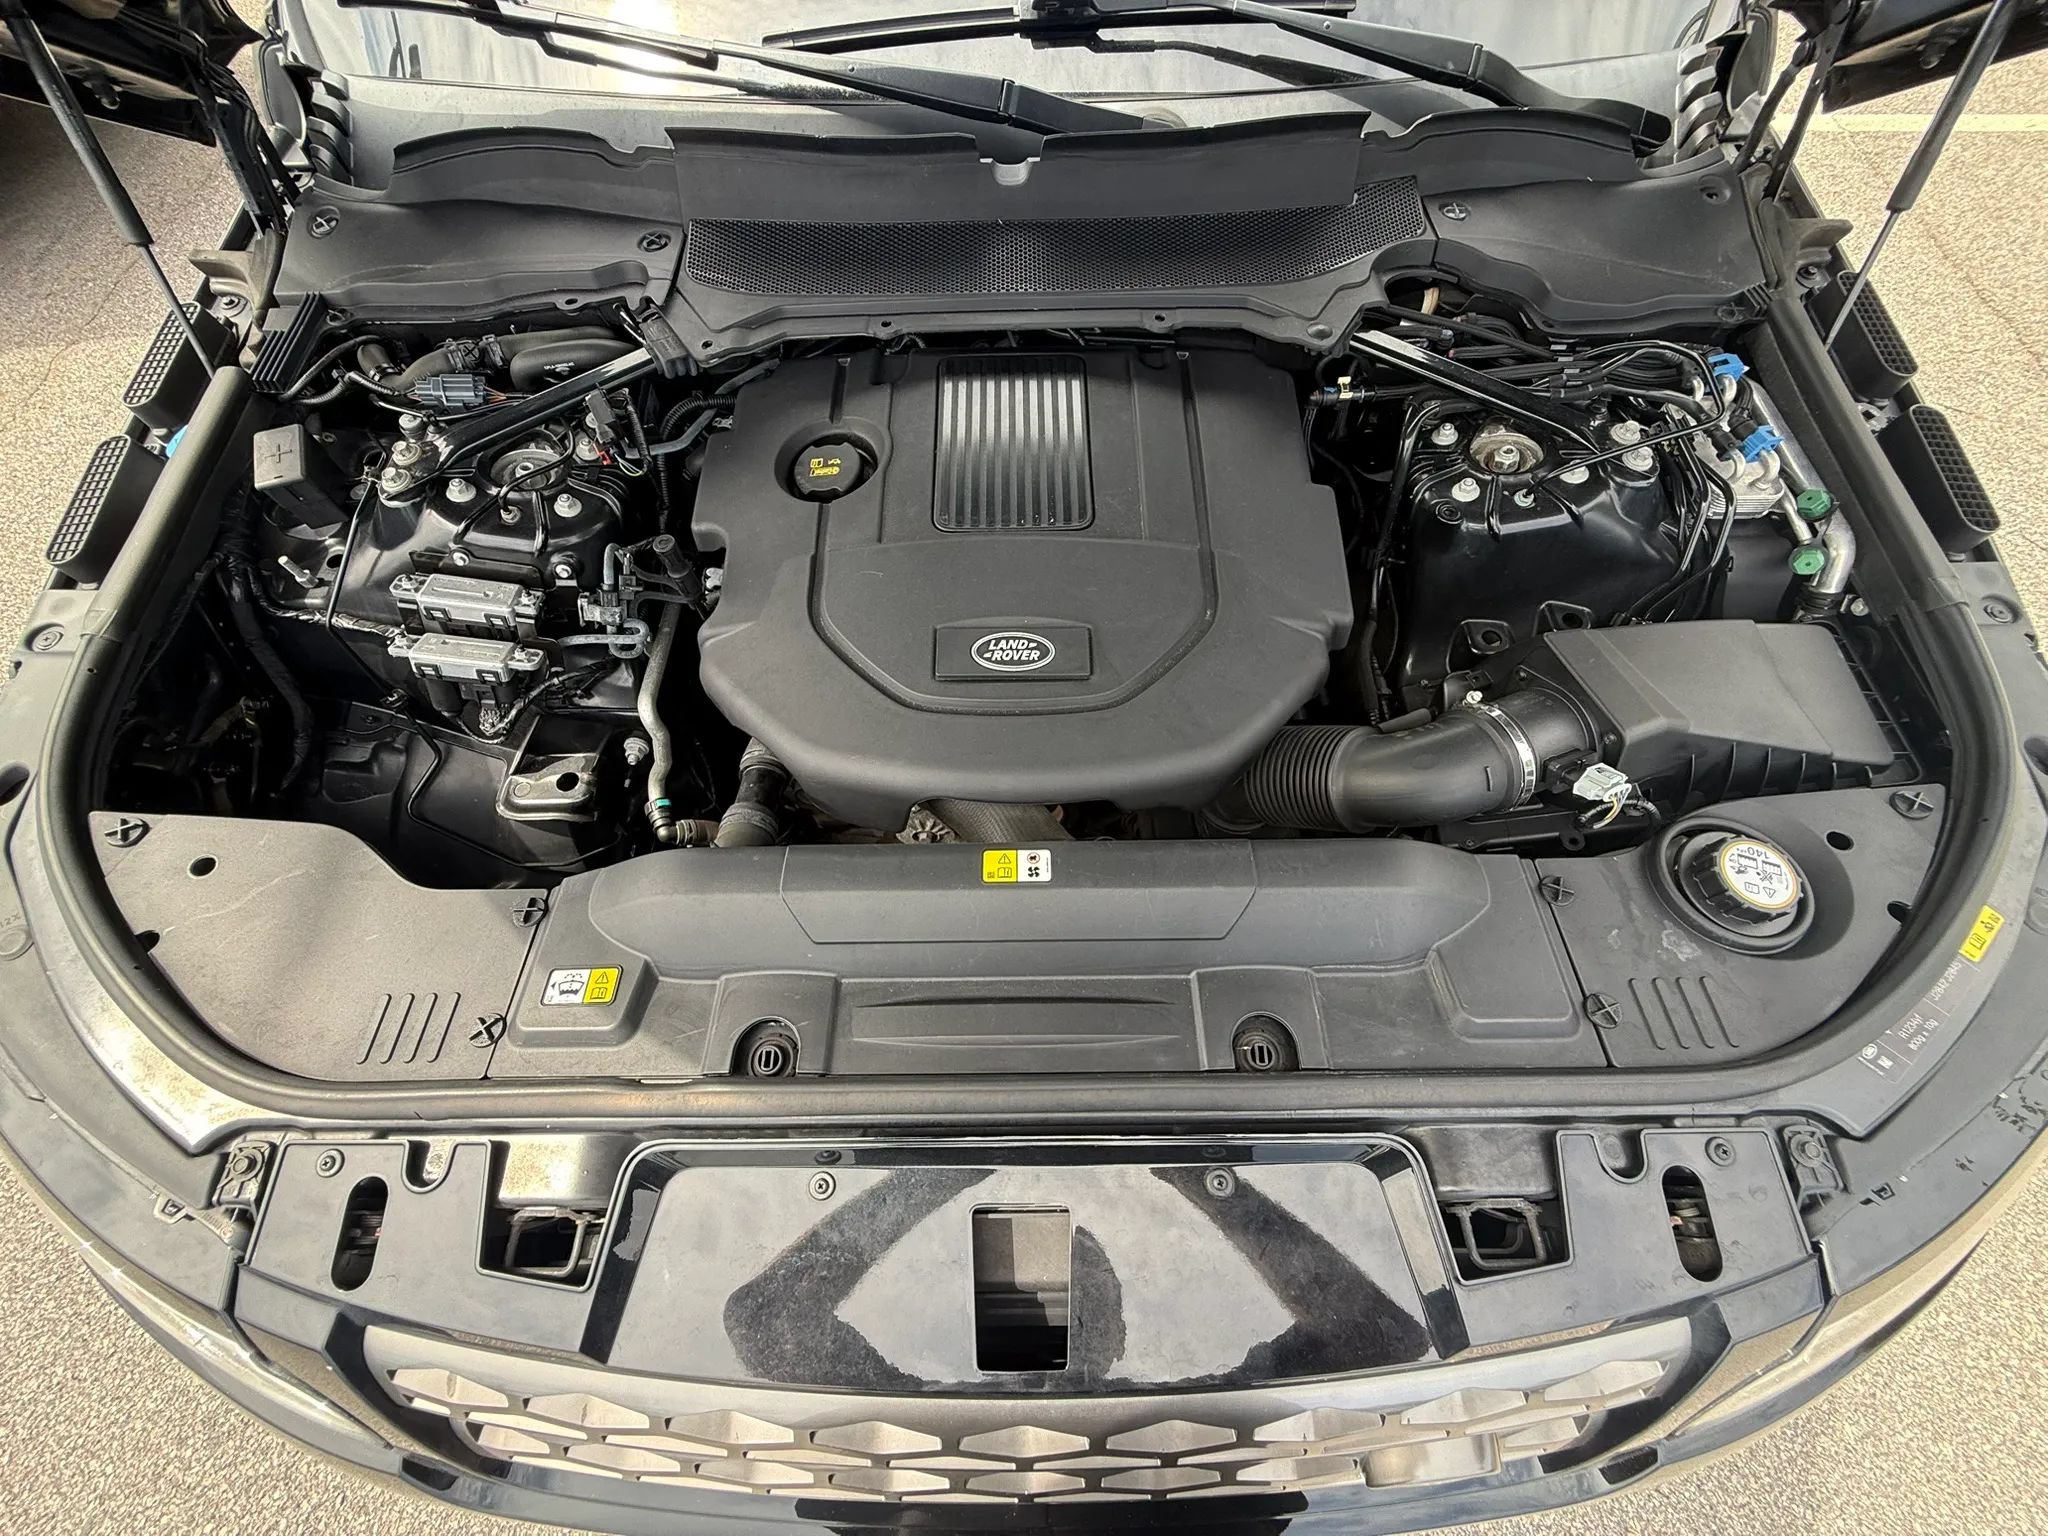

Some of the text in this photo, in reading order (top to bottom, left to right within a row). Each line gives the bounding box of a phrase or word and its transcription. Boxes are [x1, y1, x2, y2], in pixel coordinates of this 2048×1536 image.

[988, 639, 1028, 650] LAND
[991, 650, 1040, 661] ROVER
[1898, 1012, 1924, 1040] R1234yf
